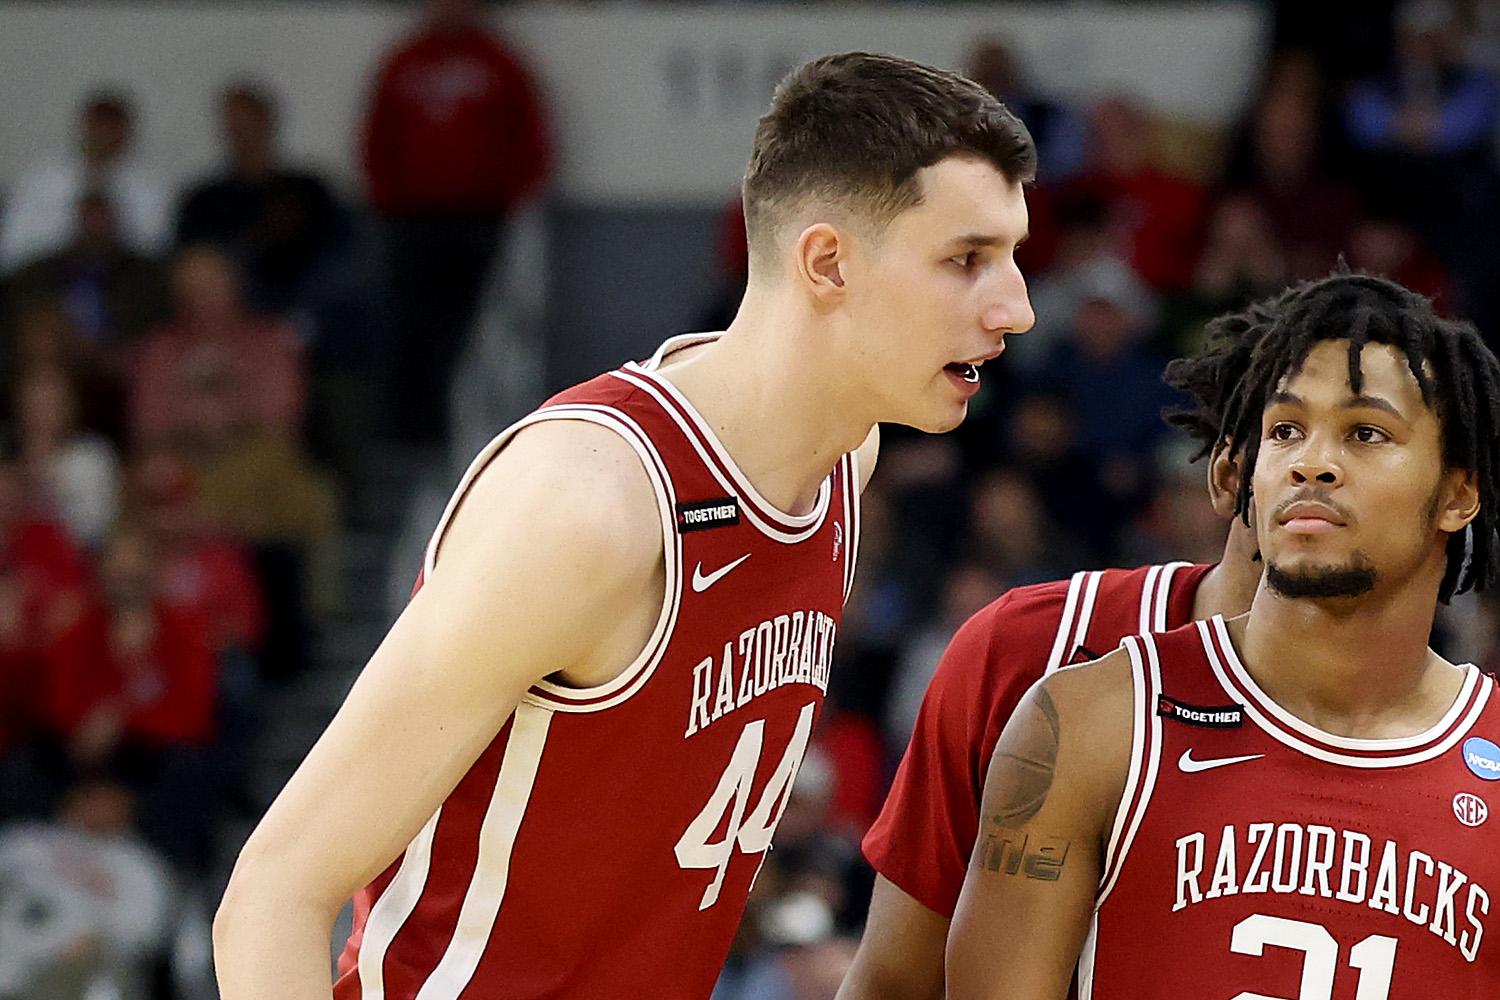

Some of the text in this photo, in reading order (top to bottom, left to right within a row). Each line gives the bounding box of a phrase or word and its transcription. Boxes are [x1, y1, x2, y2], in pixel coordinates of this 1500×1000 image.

[684, 505, 736, 524] TOGETHER
[685, 610, 836, 738] RAZORBACK
[1175, 706, 1240, 723] TOGETHER
[674, 702, 814, 911] 44
[1456, 795, 1484, 823] SEC
[1172, 823, 1490, 962] RAZORBACKS
